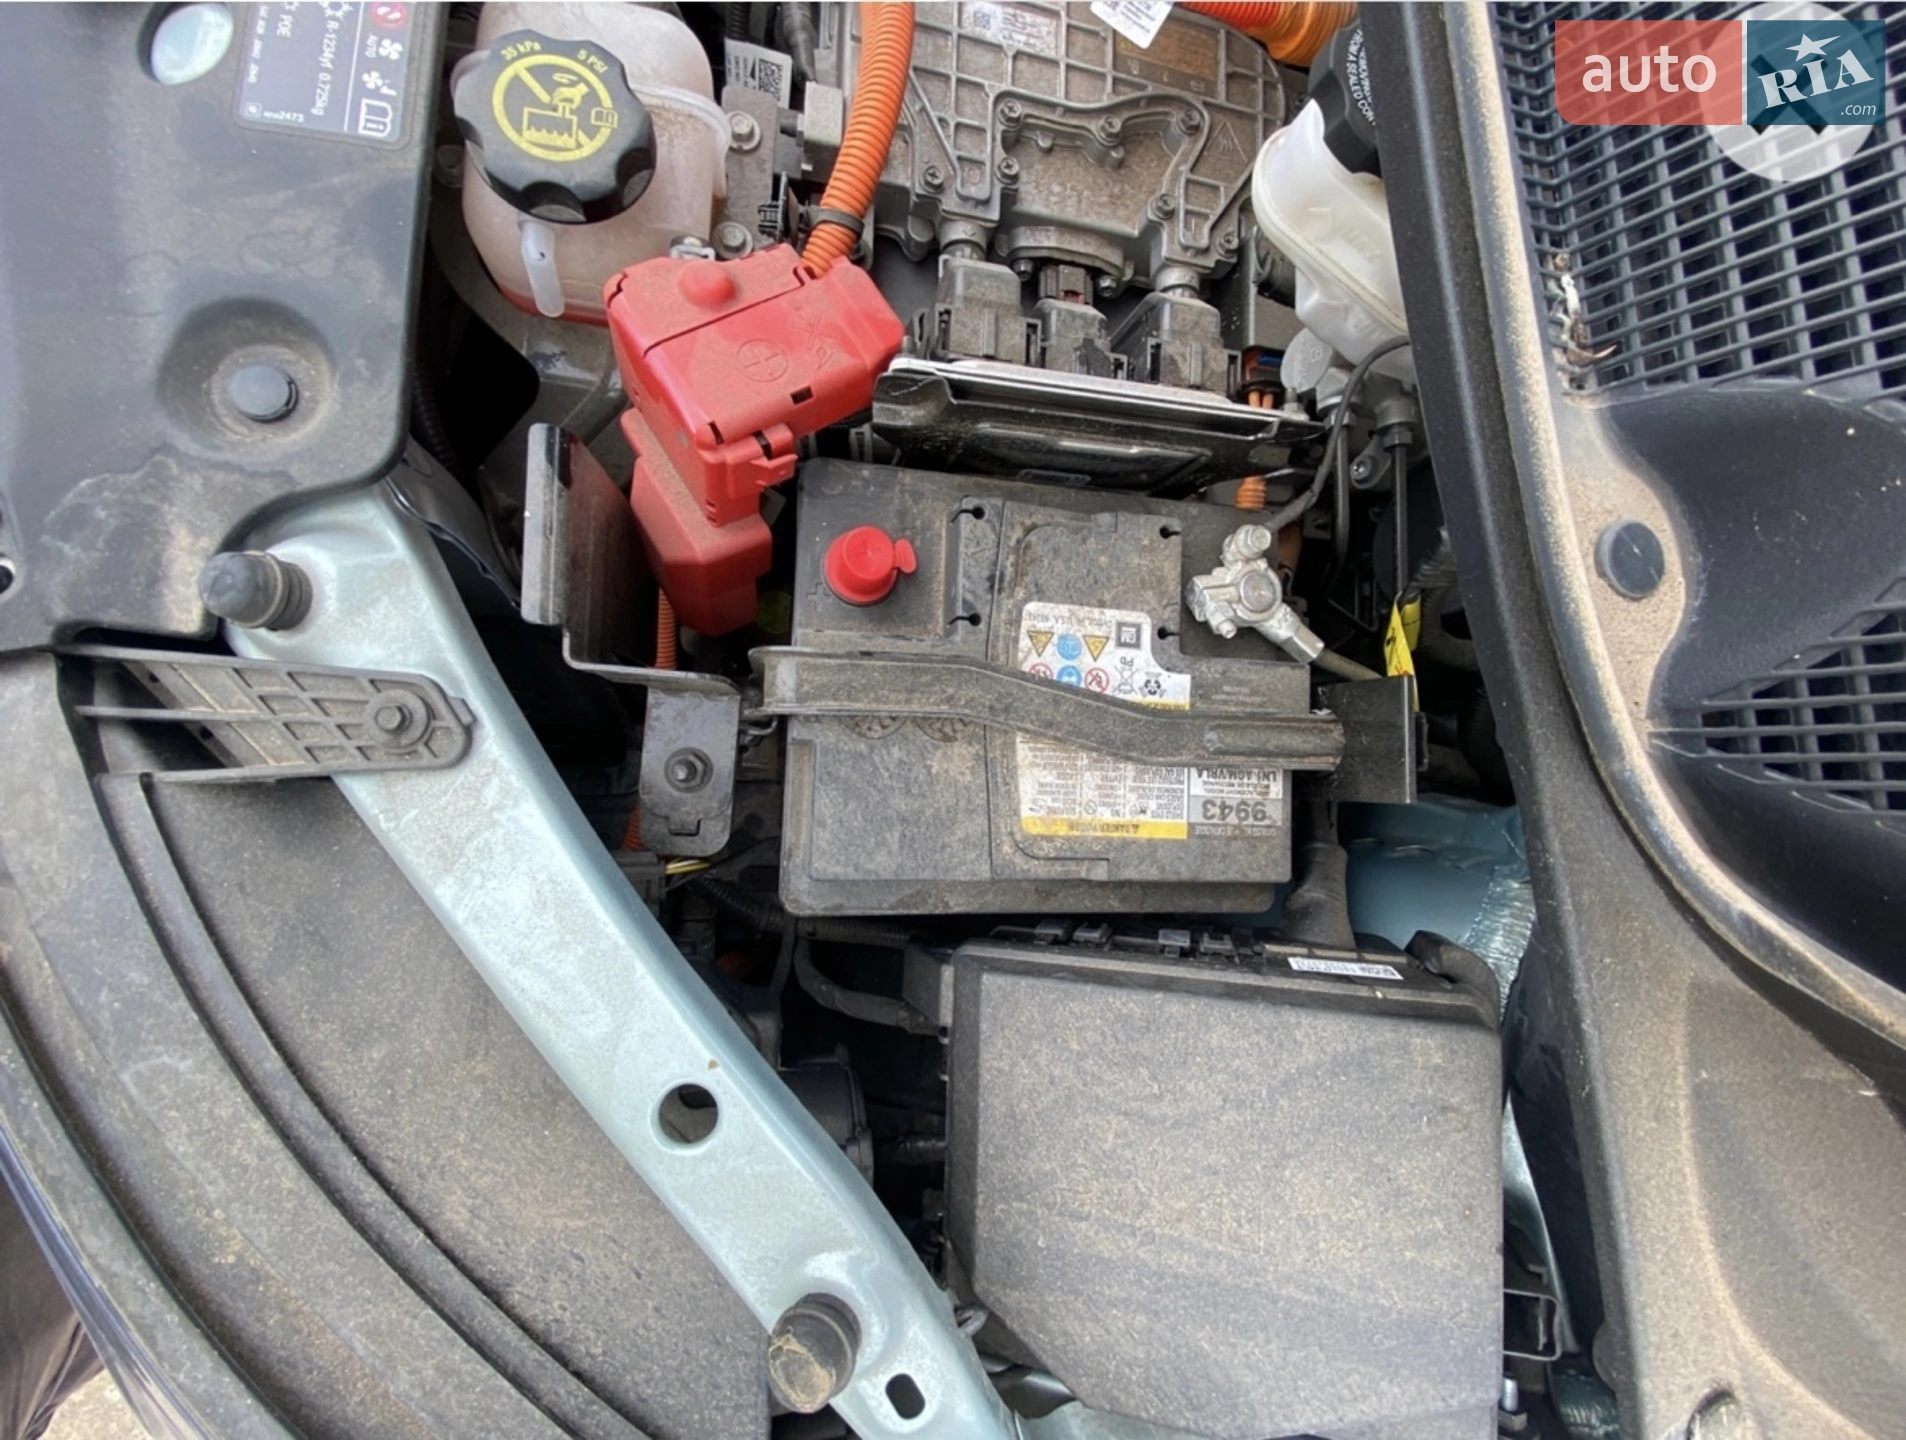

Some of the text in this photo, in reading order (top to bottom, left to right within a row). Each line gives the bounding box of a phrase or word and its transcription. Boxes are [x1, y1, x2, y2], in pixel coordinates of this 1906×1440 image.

[276, 14, 293, 38] POE
[364, 34, 379, 59] AUTO
[501, 40, 542, 61] 35 kPa
[1346, 53, 1358, 61] A
[310, 20, 340, 116] R-1234yf 0.725kg
[577, 48, 609, 74] 5 PSI
[1346, 61, 1363, 101] SEALED
[1120, 629, 1137, 644] GM
[1119, 656, 1135, 667] Pb
[1202, 798, 1267, 823] 9943
